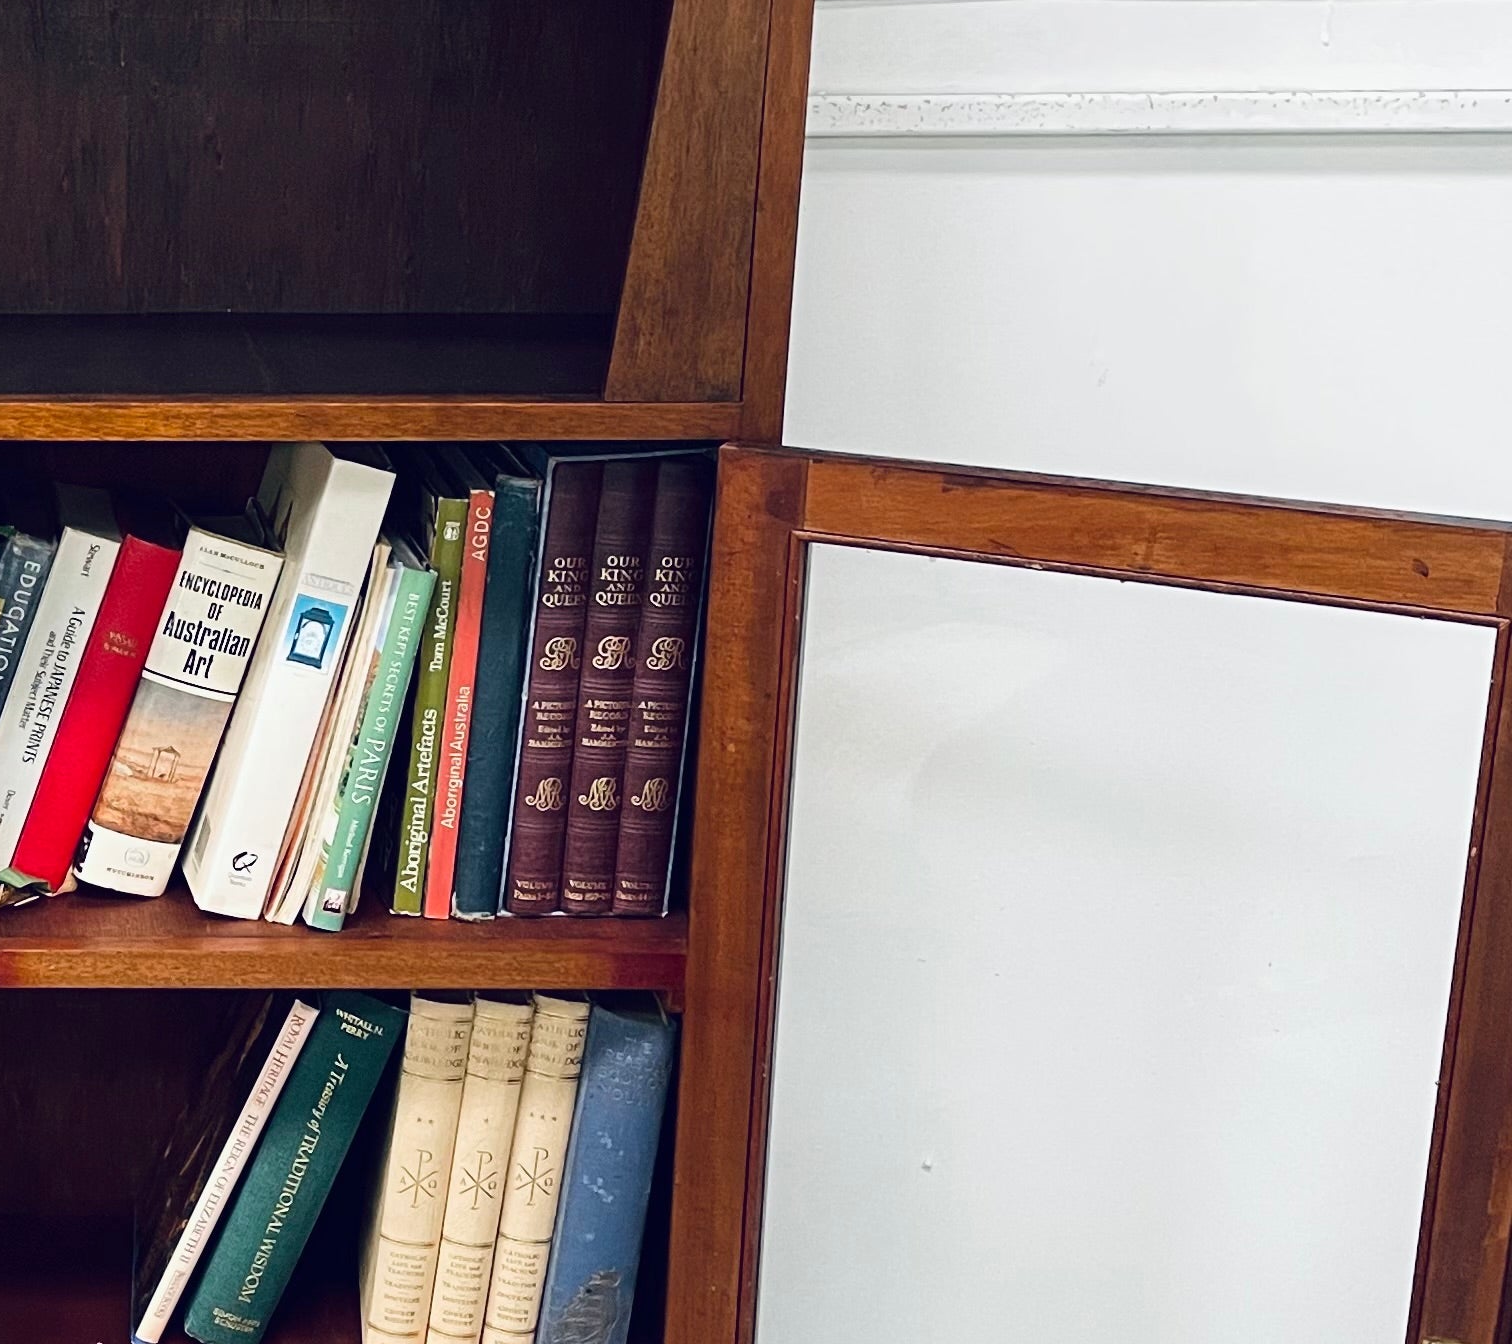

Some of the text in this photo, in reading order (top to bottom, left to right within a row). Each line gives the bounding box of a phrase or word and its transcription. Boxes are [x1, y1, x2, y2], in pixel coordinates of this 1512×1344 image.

[471, 506, 492, 563] AGDC
[80, 543, 101, 577] Stewart
[199, 545, 220, 557] ALAN
[554, 557, 587, 569] OUR
[606, 555, 640, 567] OUR
[661, 557, 695, 568] OUR
[178, 570, 264, 611] ENCYCLOPEDIA
[547, 569, 588, 582] KING
[554, 585, 582, 593] AND
[599, 568, 644, 582] KING
[606, 584, 635, 592] AND
[659, 585, 688, 593] AND
[207, 602, 225, 621] OF
[403, 592, 421, 624] BEST
[595, 591, 642, 607] QUEEN
[162, 610, 251, 658] Australian
[429, 578, 452, 673] Tom McCourt
[393, 626, 412, 659] KEPT
[182, 648, 215, 679] Art
[18, 630, 57, 730] and Their Subject Matter
[22, 606, 86, 765] A Guide to JAPANESE PRINTS
[378, 661, 403, 714] SECRETS
[373, 716, 387, 734] OF
[352, 737, 386, 807] PARIS
[440, 686, 472, 830] Aboriginal Australia
[399, 708, 438, 894] Aboriginal Artefacts
[335, 1008, 373, 1032] WHITALL
[340, 1022, 371, 1040] PERRY
[566, 1042, 581, 1053] OF
[179, 1013, 306, 1265] ROYAL HERITAGE THE REIGN OF ELIZABETH II
[238, 1053, 349, 1304] A Treasury of TRADITIONAL WISDOM
